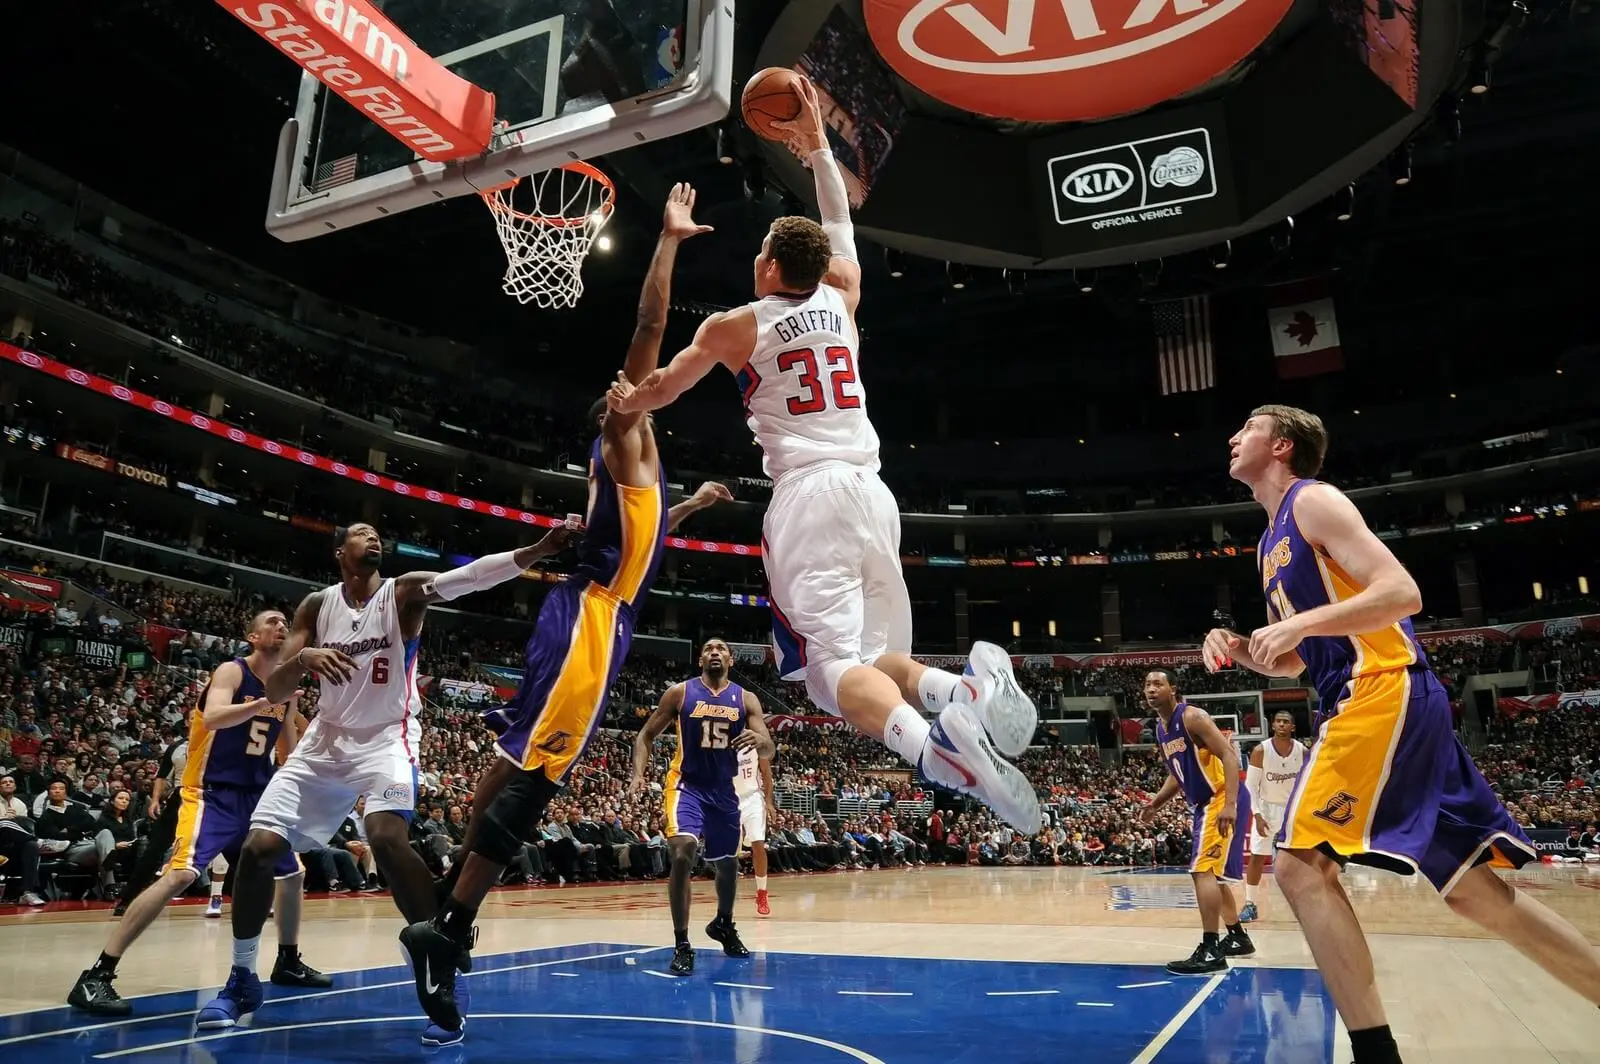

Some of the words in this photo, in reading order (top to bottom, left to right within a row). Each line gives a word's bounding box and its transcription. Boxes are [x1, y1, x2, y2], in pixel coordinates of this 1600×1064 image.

[234, 3, 362, 88] State
[345, 85, 455, 153] Farm
[1074, 170, 1123, 197] KIA
[1092, 215, 1138, 230] OFFICIAL
[1140, 206, 1183, 221] VEHICLE
[774, 309, 842, 344] GRIFFIN
[776, 346, 861, 416] 32
[117, 462, 168, 488] TOYOTA
[1120, 554, 1150, 562] DELTA
[1154, 551, 1190, 561] STAPLES
[75, 655, 113, 668] CKETS
[76, 639, 115, 659] BARRYS
[1161, 655, 1204, 665] CLIPPERS
[372, 657, 390, 685] 6
[689, 700, 740, 722] LAKERS
[245, 721, 271, 757] 5
[701, 719, 730, 750] 15
[741, 767, 753, 780] 15
